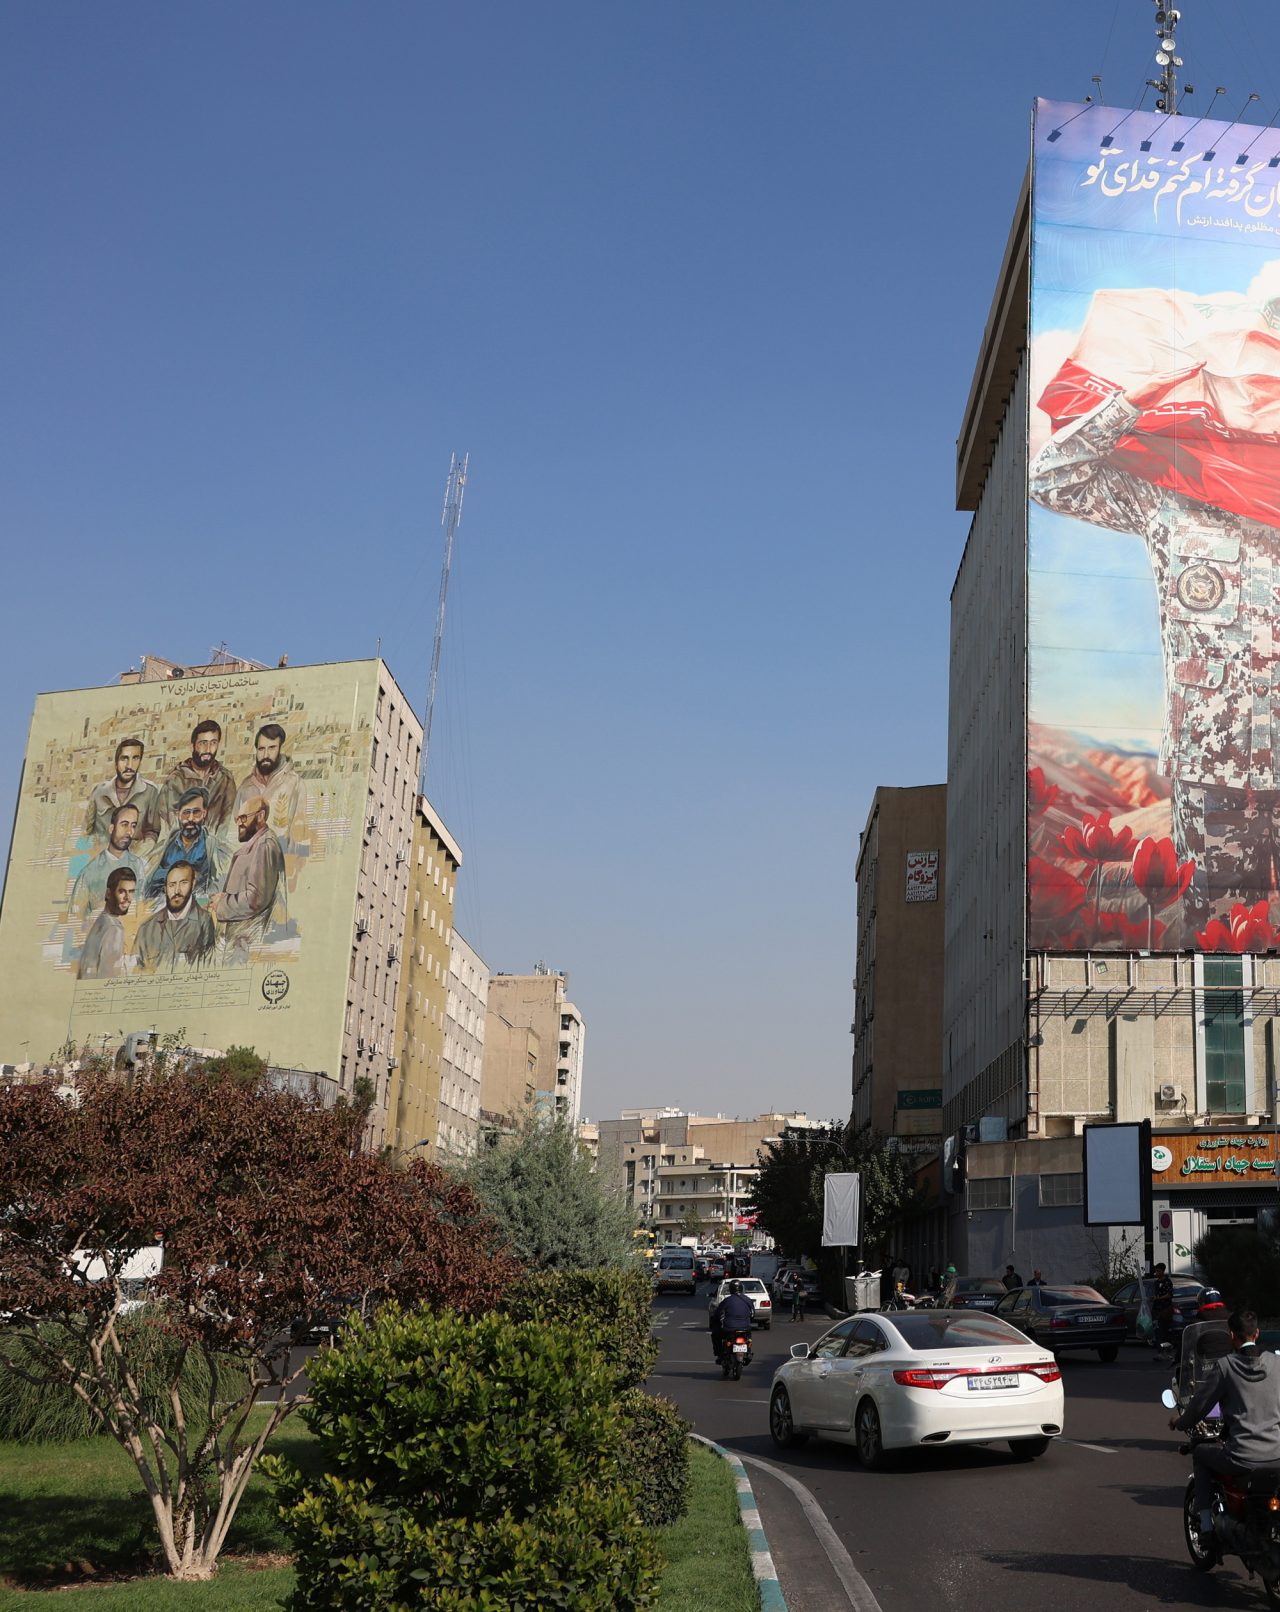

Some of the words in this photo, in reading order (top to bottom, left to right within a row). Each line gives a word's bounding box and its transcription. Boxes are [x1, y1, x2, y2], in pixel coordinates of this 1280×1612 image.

[1080, 148, 1124, 186] تو
[1101, 157, 1165, 197] فدای
[1153, 152, 1203, 225] کنم
[1187, 216, 1212, 228] ارتش
[1213, 218, 1243, 232] پدافند
[1244, 222, 1274, 233] مظلوم
[160, 683, 175, 695] ۳۷
[174, 682, 196, 696] اداری
[196, 680, 221, 694] تجاری
[222, 677, 260, 690] ساختمان
[1230, 1136, 1248, 1148] جهاد
[1183, 1156, 1222, 1175] استقلال
[1225, 1156, 1250, 1175] جهاد
